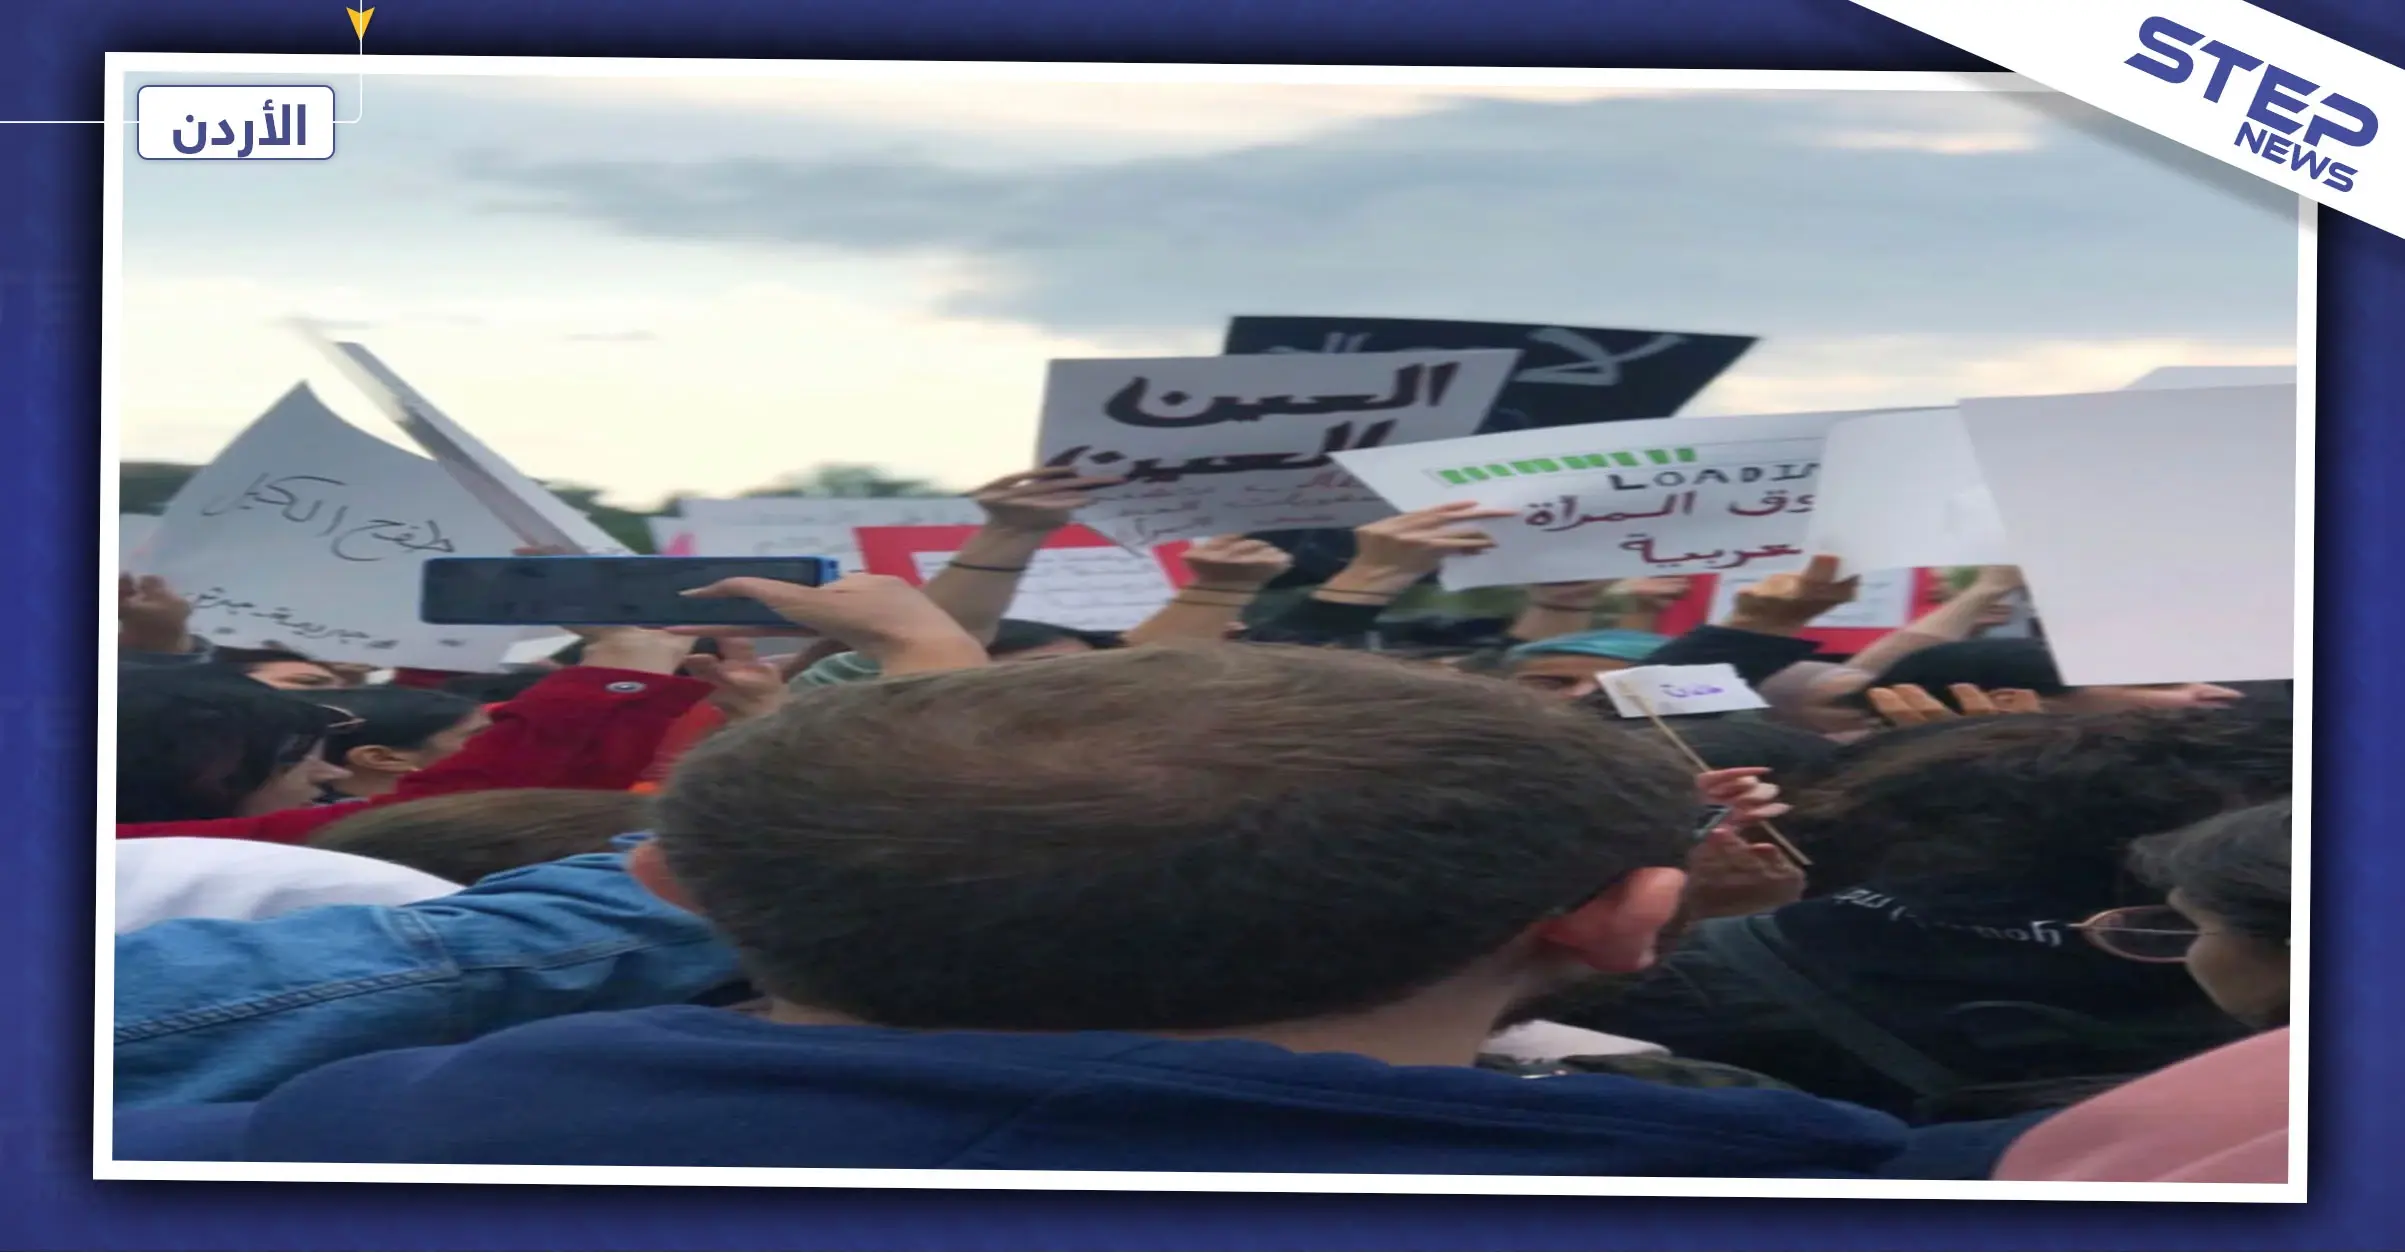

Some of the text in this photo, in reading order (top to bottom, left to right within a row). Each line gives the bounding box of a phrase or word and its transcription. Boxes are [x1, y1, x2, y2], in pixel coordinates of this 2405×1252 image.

[1104, 362, 1461, 428] العين
[1524, 491, 1698, 532] المرأة
[331, 518, 458, 562] طفح
